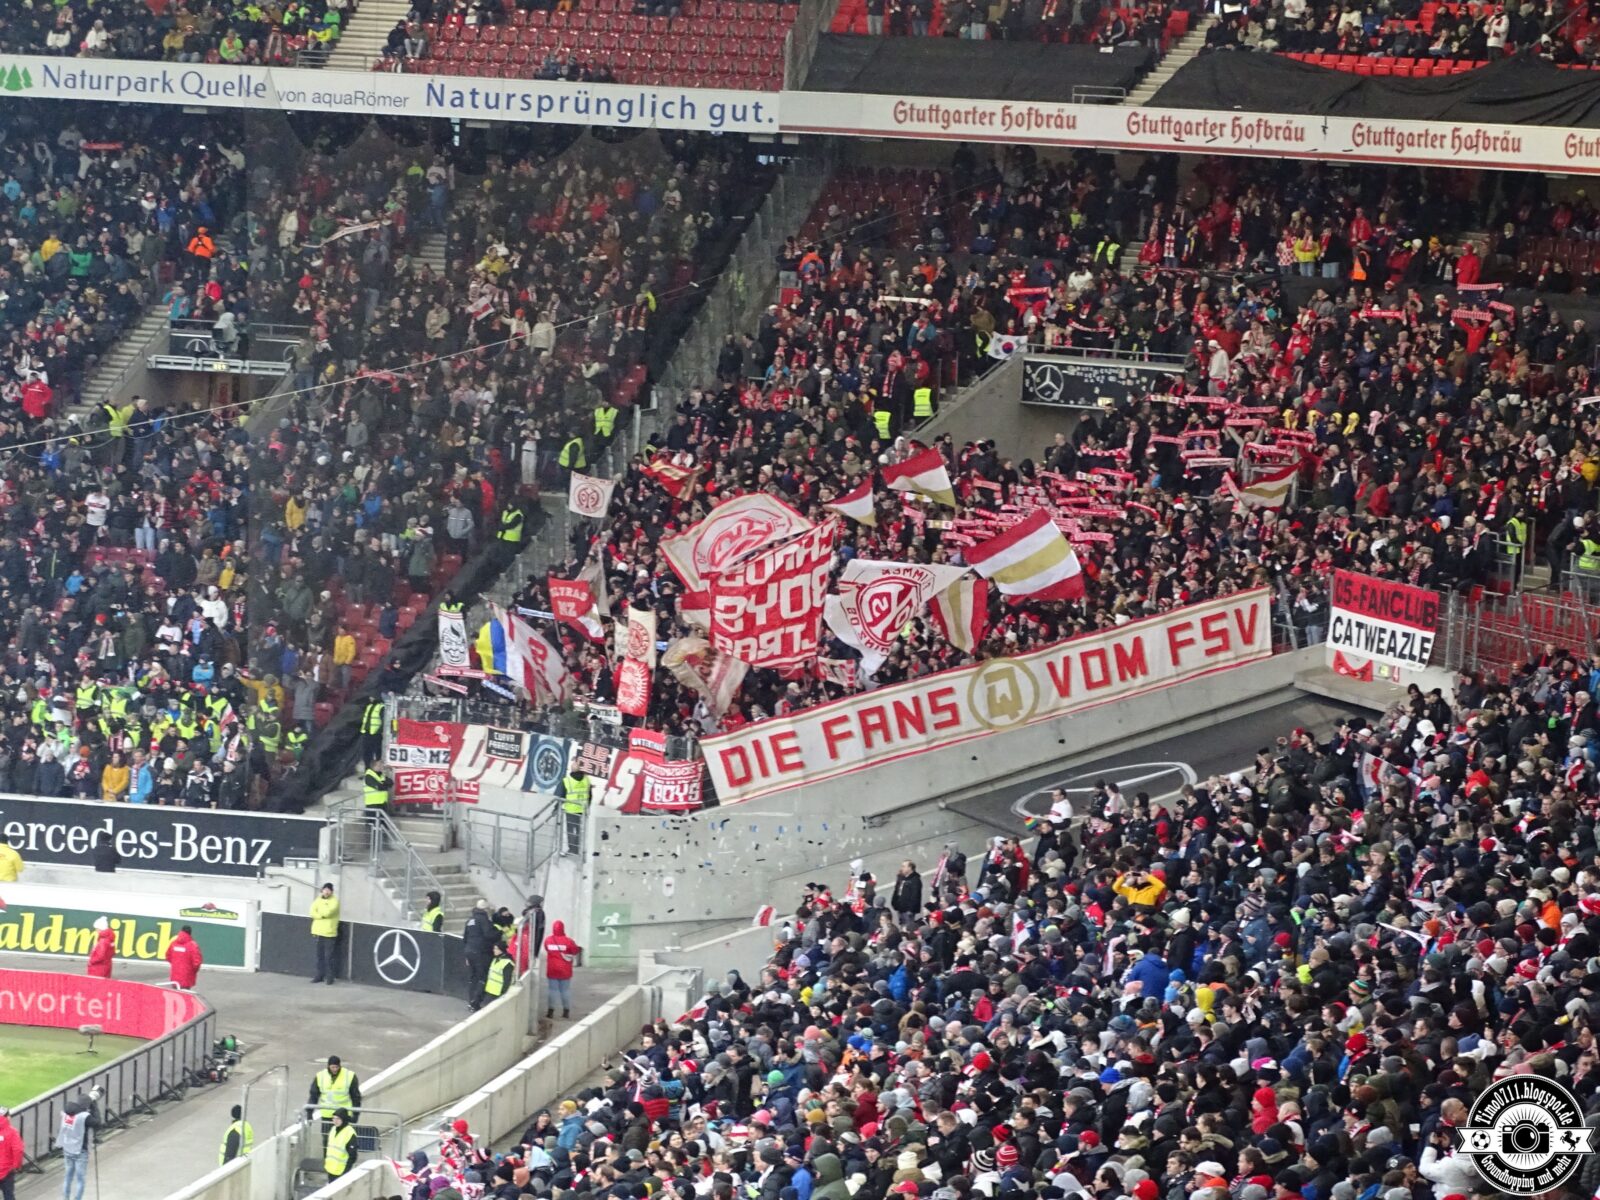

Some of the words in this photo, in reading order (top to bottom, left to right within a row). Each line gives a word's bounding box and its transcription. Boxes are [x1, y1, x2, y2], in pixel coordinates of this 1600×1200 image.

[42, 64, 174, 97] Naturpark
[181, 71, 267, 99] Quelle
[277, 88, 306, 103] von
[311, 89, 410, 110] aquaRömer
[426, 82, 696, 123] Natursprünglich
[709, 100, 775, 127] gut.
[893, 100, 996, 130] Stuttgarter
[1001, 105, 1077, 131] Hofbräu
[1126, 111, 1226, 140] Stuttgarter
[1231, 115, 1305, 143] Hofbräu
[1352, 122, 1447, 153] Stuttgarter
[1451, 127, 1522, 155] Hofbräu
[1332, 615, 1432, 665] CATWEAZLE
[718, 731, 804, 788] DIE
[821, 686, 962, 760] FANS
[1046, 636, 1148, 699] VOM
[1167, 602, 1262, 667] FSV
[0, 811, 273, 867] ercedes-Benz
